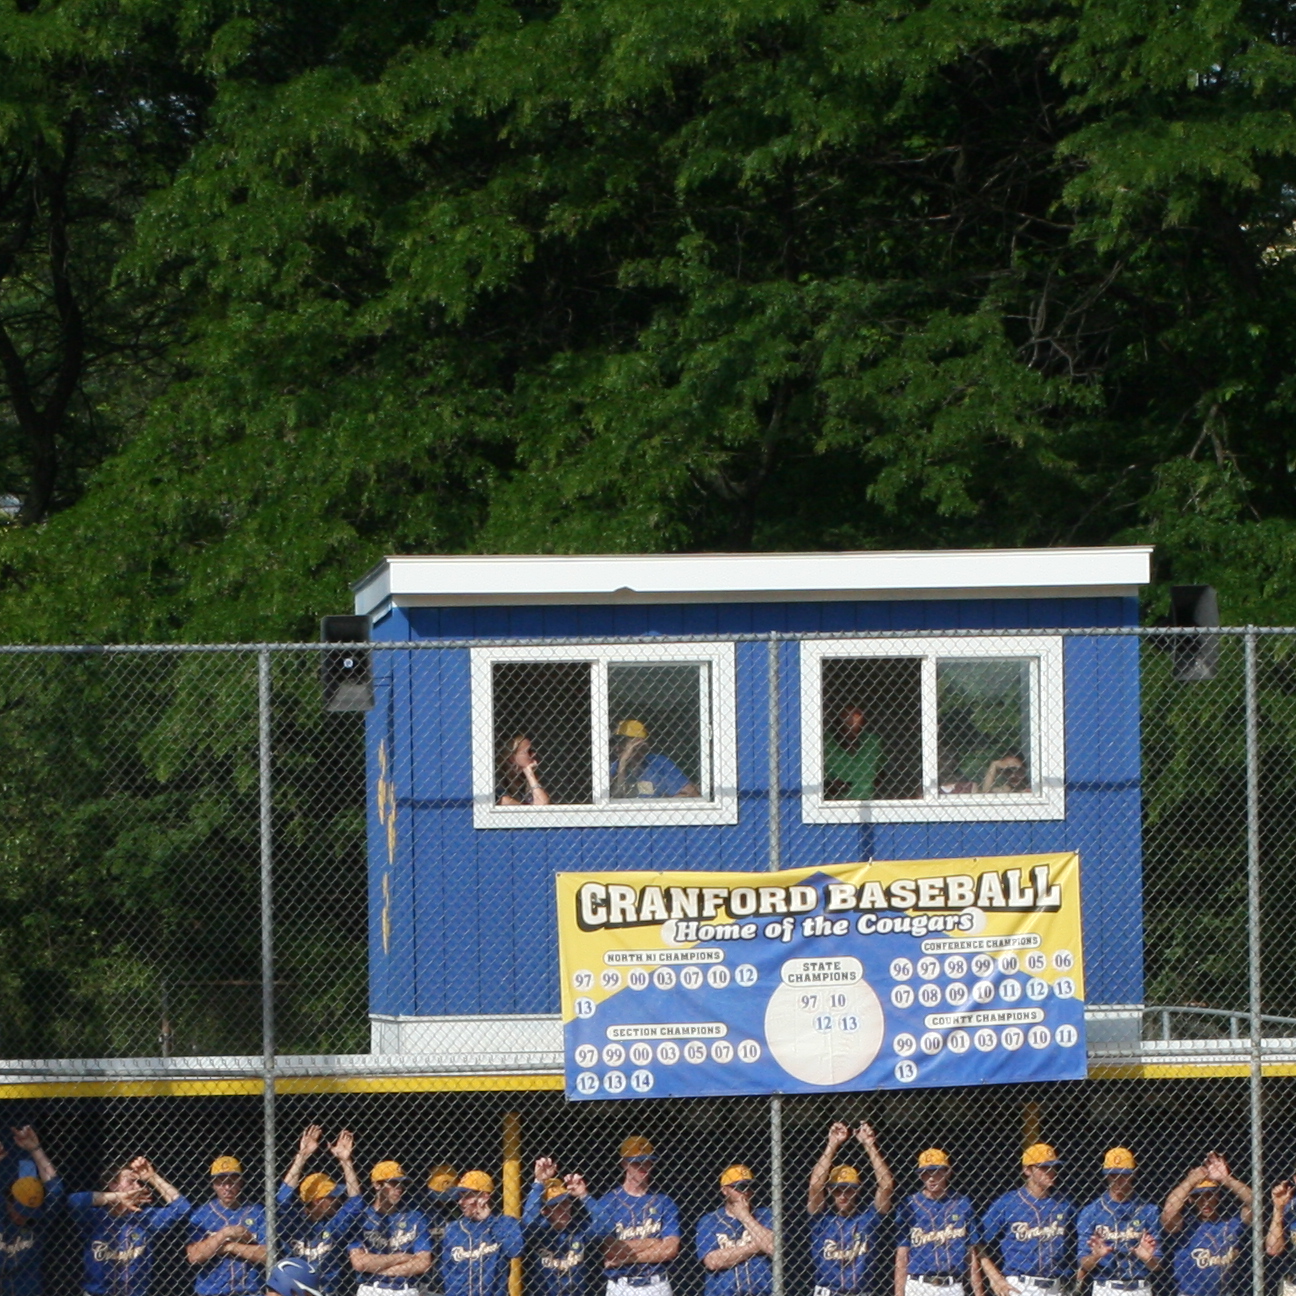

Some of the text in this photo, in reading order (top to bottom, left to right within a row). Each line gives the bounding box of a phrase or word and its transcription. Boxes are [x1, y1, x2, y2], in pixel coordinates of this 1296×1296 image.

[577, 864, 1062, 931] CRANFORD BASEBALL
[675, 913, 974, 942] Home of the Cougars
[924, 937, 1038, 950] CONFERENCE CHAMPIONS
[607, 953, 643, 962] NORTH
[659, 952, 721, 961] CHAMPIONS
[802, 962, 841, 972] STATE
[893, 954, 1070, 976] 96 97 98 99 00 05 06
[576, 969, 753, 986] 97 99 00 03 07 10 12
[788, 971, 856, 983] CHAMPIONS
[895, 981, 1072, 1003] 07 08 09 10 11 12 13
[801, 995, 845, 1008] 97 10
[577, 1003, 592, 1014] 13
[817, 1016, 857, 1029] 12 13
[932, 1012, 1037, 1026] COUNTY CHAMPIONS
[613, 1027, 721, 1036] SECTION CHAMPIONS
[898, 1030, 1072, 1051] 99 00 01 03 07 10 11
[579, 1045, 757, 1062] 97 99 00 03 05 07 10
[899, 1065, 913, 1078] 13
[580, 1075, 650, 1089] 12 13 14
